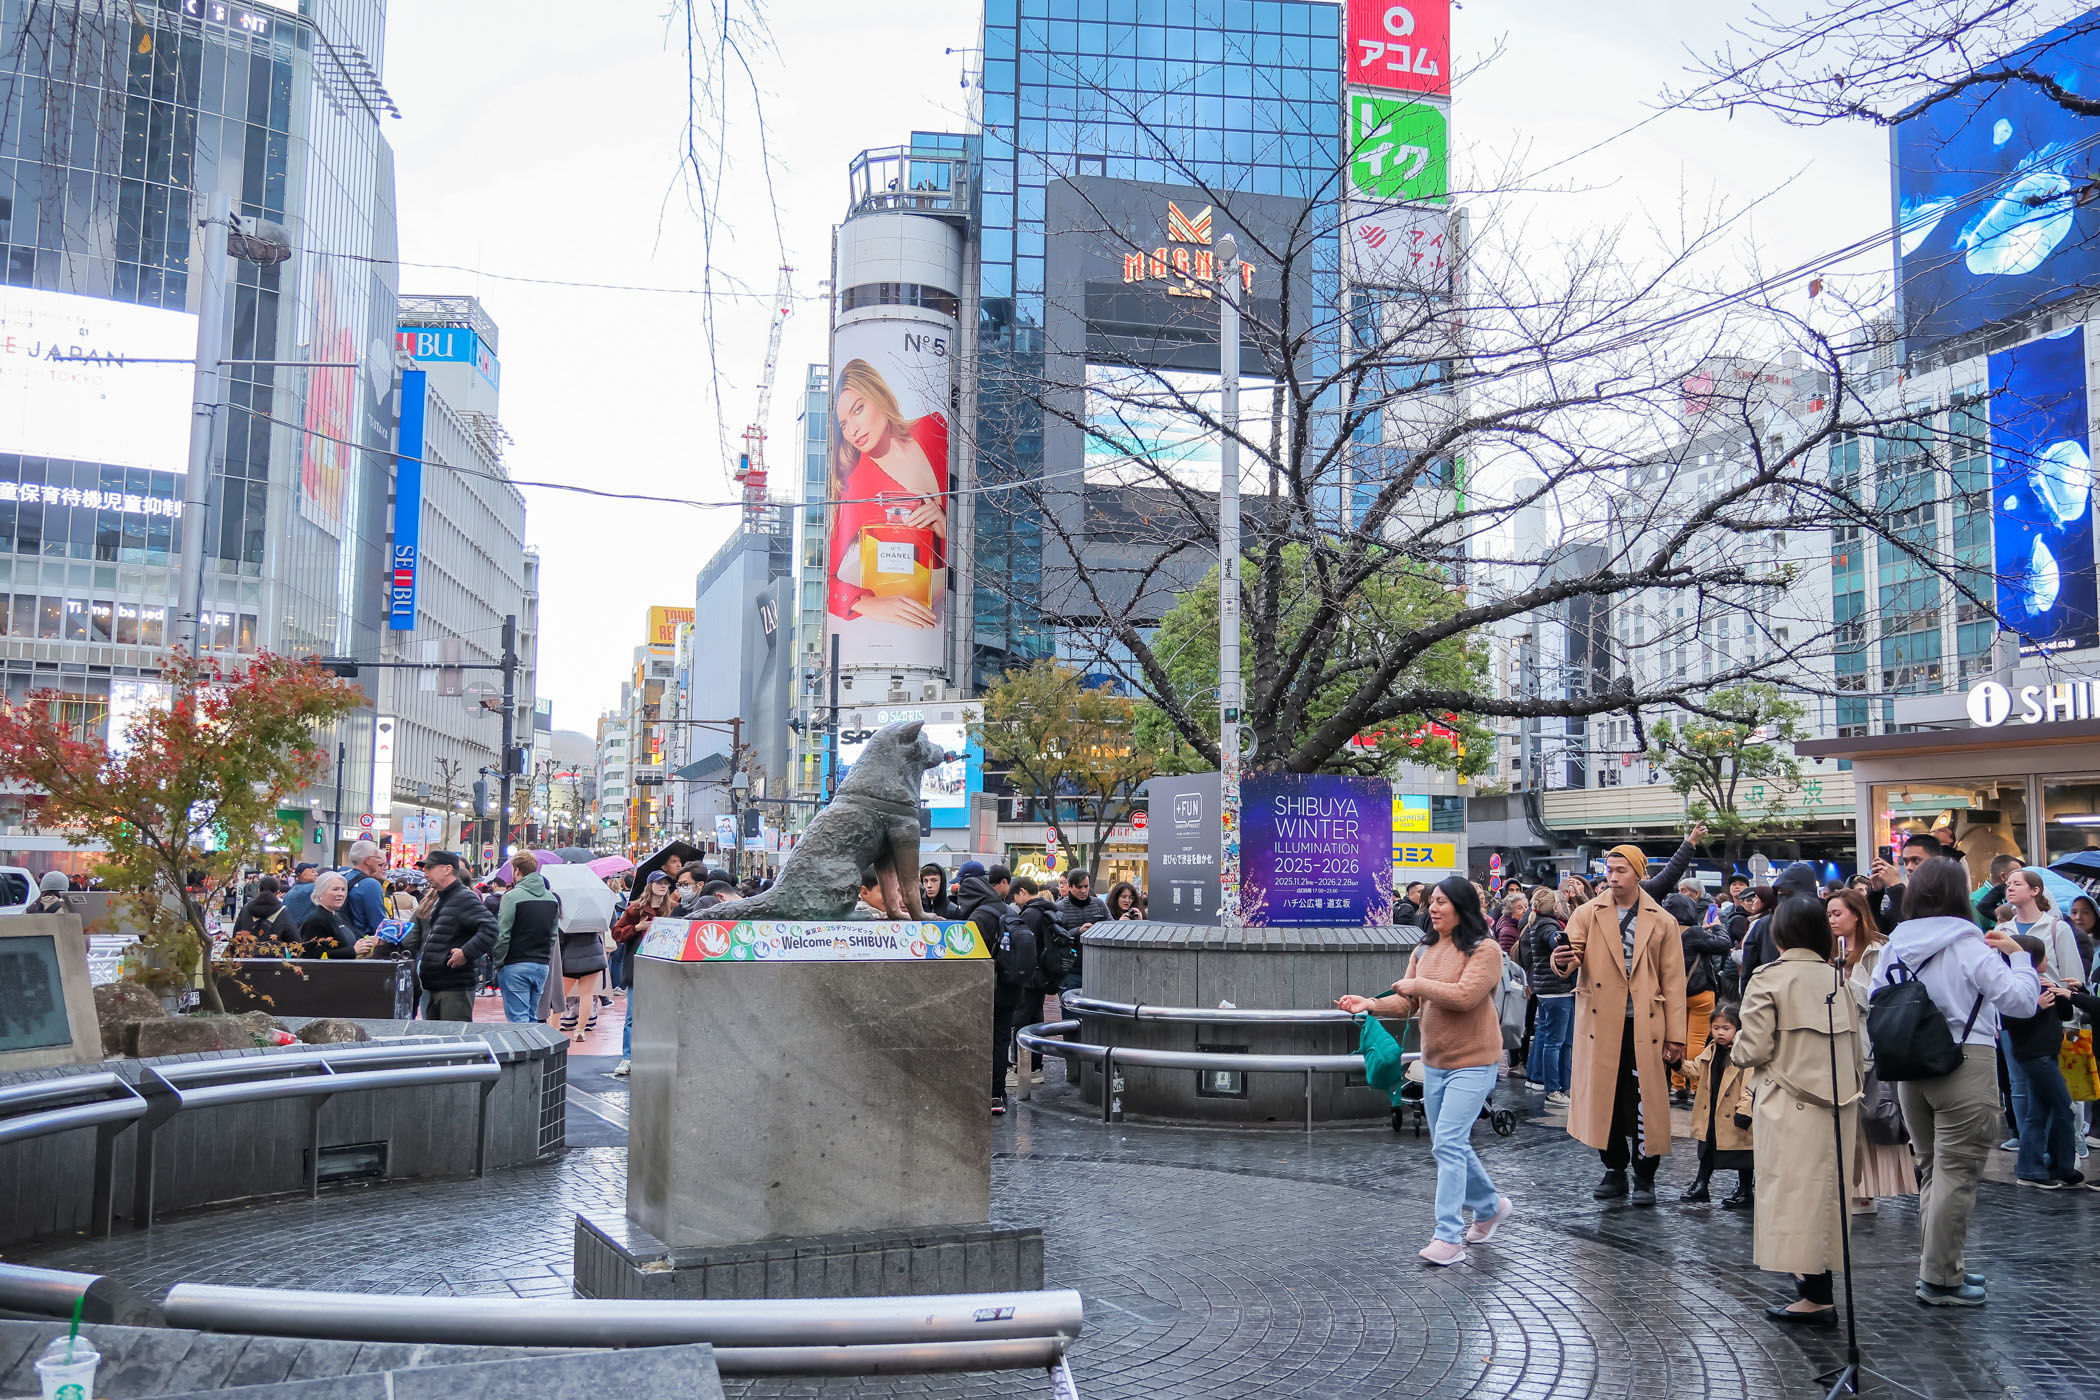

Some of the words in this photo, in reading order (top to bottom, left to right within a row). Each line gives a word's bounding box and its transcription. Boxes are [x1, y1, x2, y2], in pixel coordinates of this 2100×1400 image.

[1358, 39, 1440, 77] アコム
[1124, 248, 1256, 297] MAGNT
[27, 340, 125, 368] JAPAN
[880, 552, 912, 560] CHANEL
[67, 601, 110, 616] Time
[118, 604, 164, 621] based
[659, 625, 676, 641] RE
[840, 729, 877, 745] SP
[1744, 785, 1764, 801] JR
[1274, 795, 1359, 818] SHIBUYA
[1274, 818, 1359, 840] WINTER
[1274, 841, 1359, 855] ILLUMINATION
[1274, 857, 1360, 874] 2025-2026
[781, 936, 832, 950] Welcome
[848, 935, 898, 950] SHIBUYA
